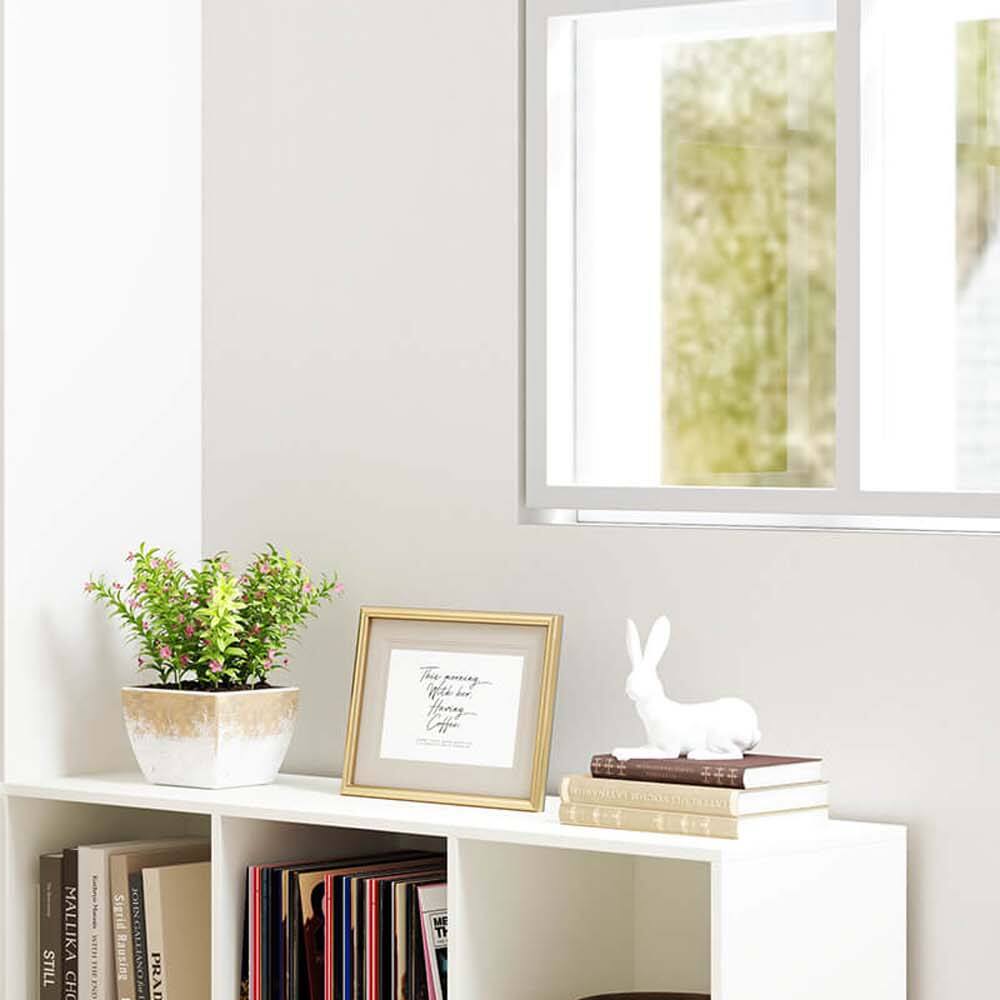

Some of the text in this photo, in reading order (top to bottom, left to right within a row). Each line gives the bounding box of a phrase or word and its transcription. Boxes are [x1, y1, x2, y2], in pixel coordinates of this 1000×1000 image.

[113, 894, 125, 931] Sigrid
[131, 888, 139, 917] JOHN
[64, 886, 77, 961] MALLIKA
[43, 949, 56, 988] STILL
